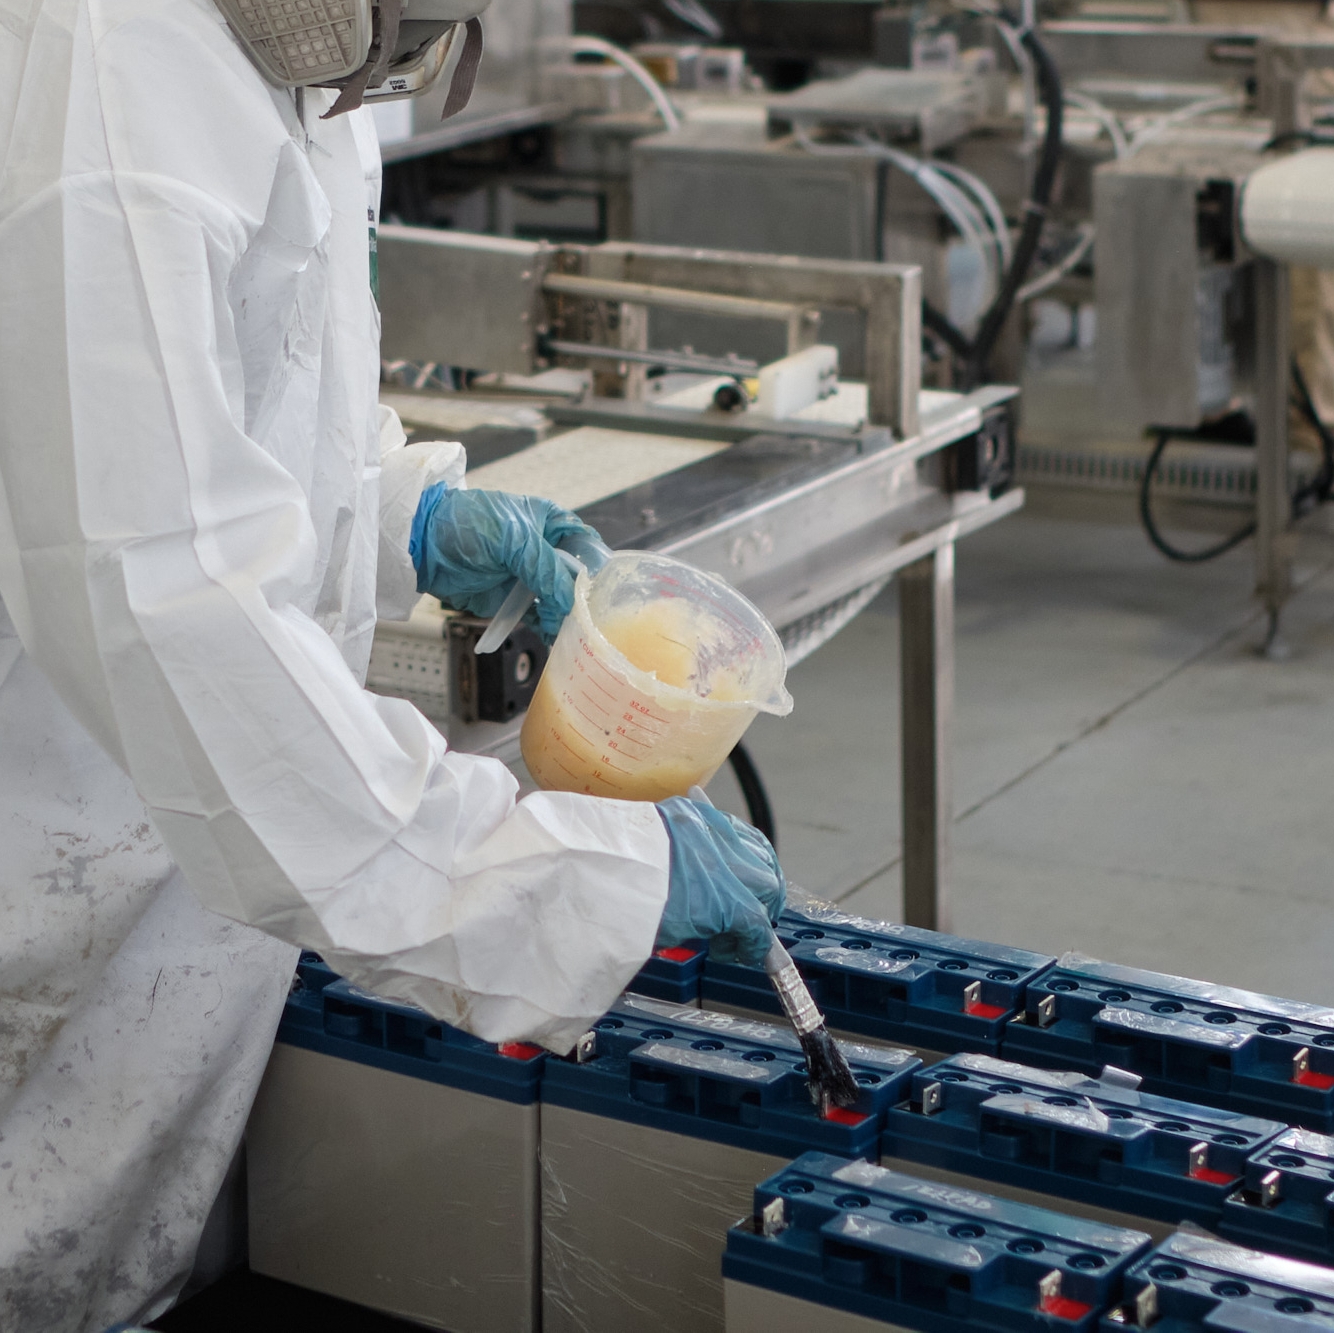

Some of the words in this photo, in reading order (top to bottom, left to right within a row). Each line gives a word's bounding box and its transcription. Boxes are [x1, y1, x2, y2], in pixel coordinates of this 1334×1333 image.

[392, 83, 408, 91] 3M
[623, 711, 633, 722] 28
[616, 725, 627, 735] 24
[608, 740, 618, 750] 20
[601, 754, 610, 764] 16
[592, 769, 602, 778] 12
